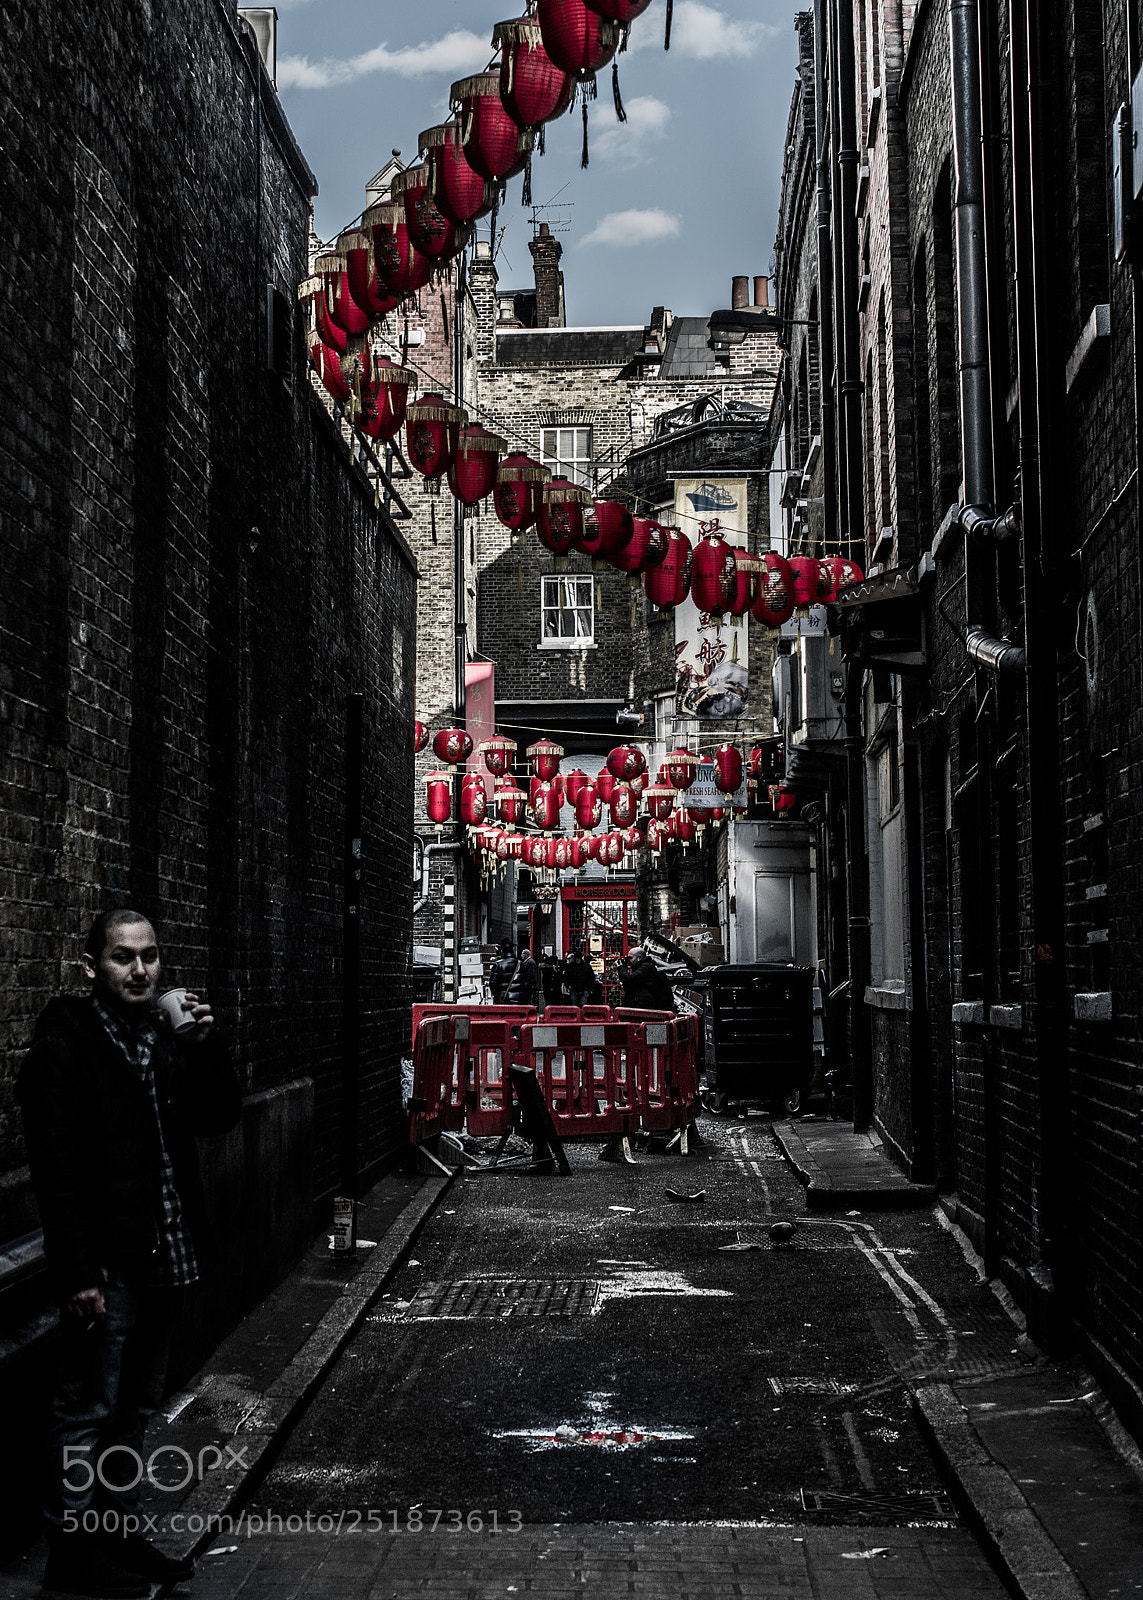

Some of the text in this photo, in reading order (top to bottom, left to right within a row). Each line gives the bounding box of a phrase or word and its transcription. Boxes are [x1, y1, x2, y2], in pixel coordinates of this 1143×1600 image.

[686, 786, 703, 795] FRESH
[575, 888, 603, 897] HORSE
[604, 888, 611, 896] &
